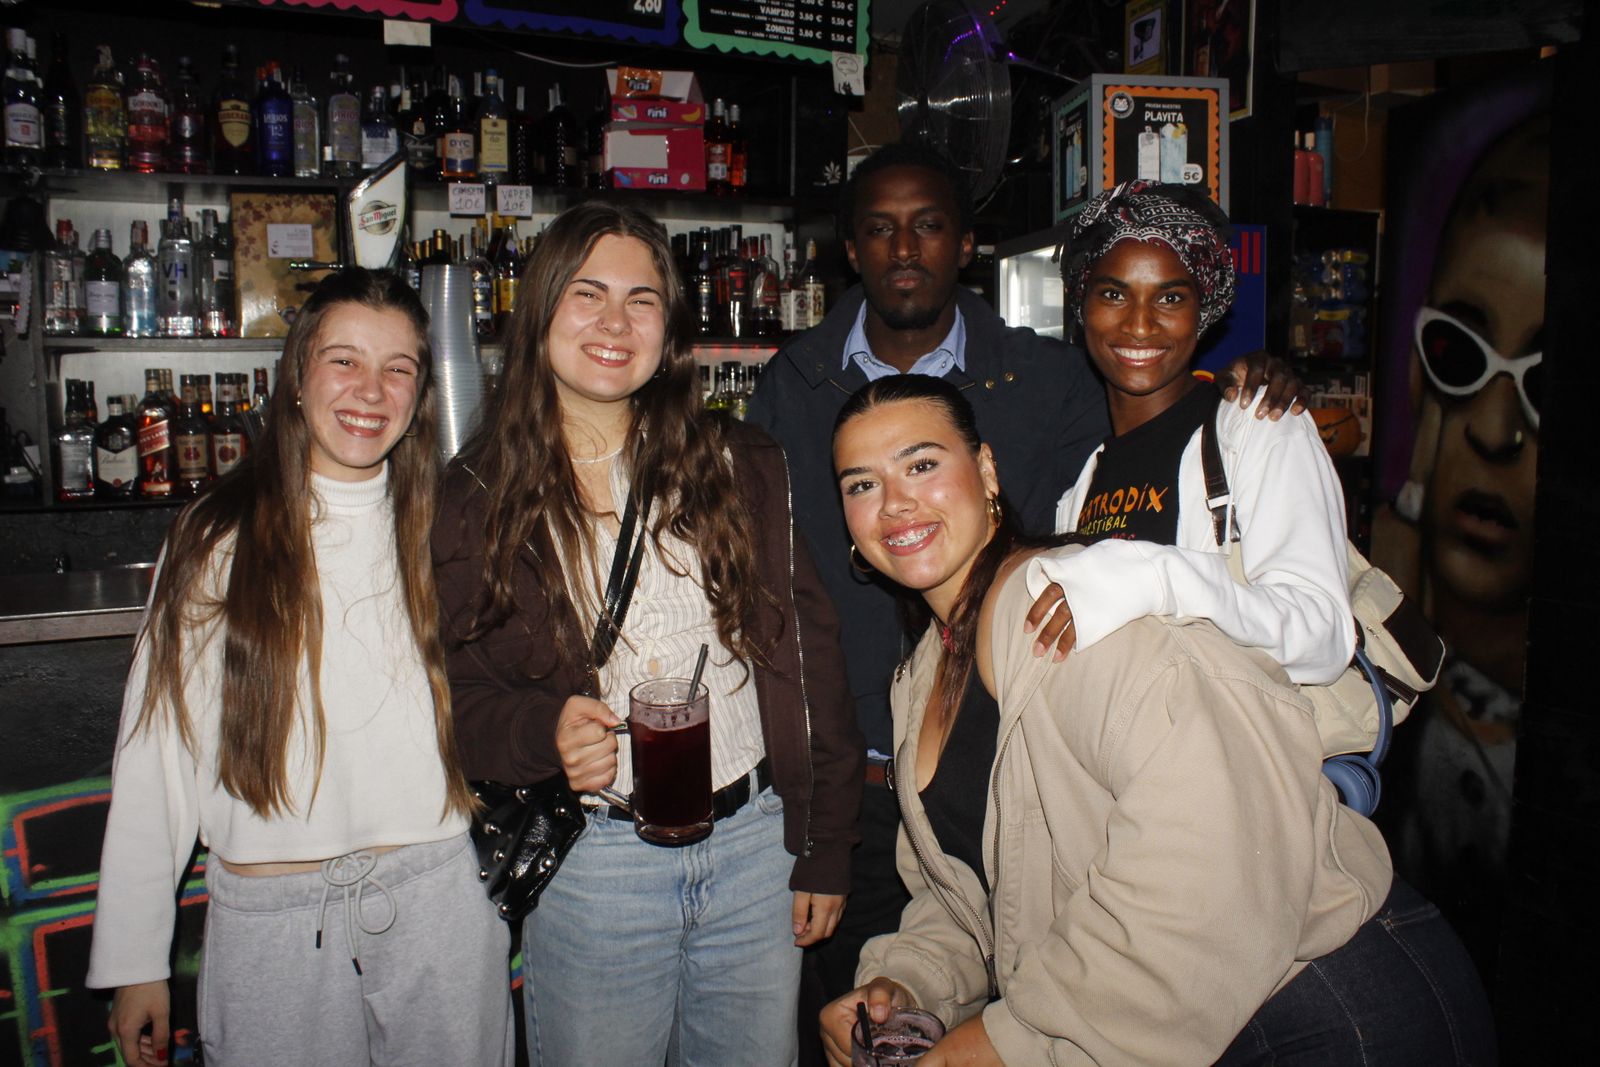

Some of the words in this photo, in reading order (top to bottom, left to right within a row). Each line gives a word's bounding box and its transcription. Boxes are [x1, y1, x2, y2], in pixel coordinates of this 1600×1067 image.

[760, 5, 795, 18] VAMPIRO
[765, 23, 795, 35] ZOMBIE
[1144, 110, 1184, 123] PLAYITA
[449, 139, 471, 148] DYC
[1183, 171, 1200, 181] 5€
[502, 188, 532, 199] VAPER
[359, 213, 373, 226] San
[373, 209, 397, 222] Miguel
[162, 263, 188, 279] VH
